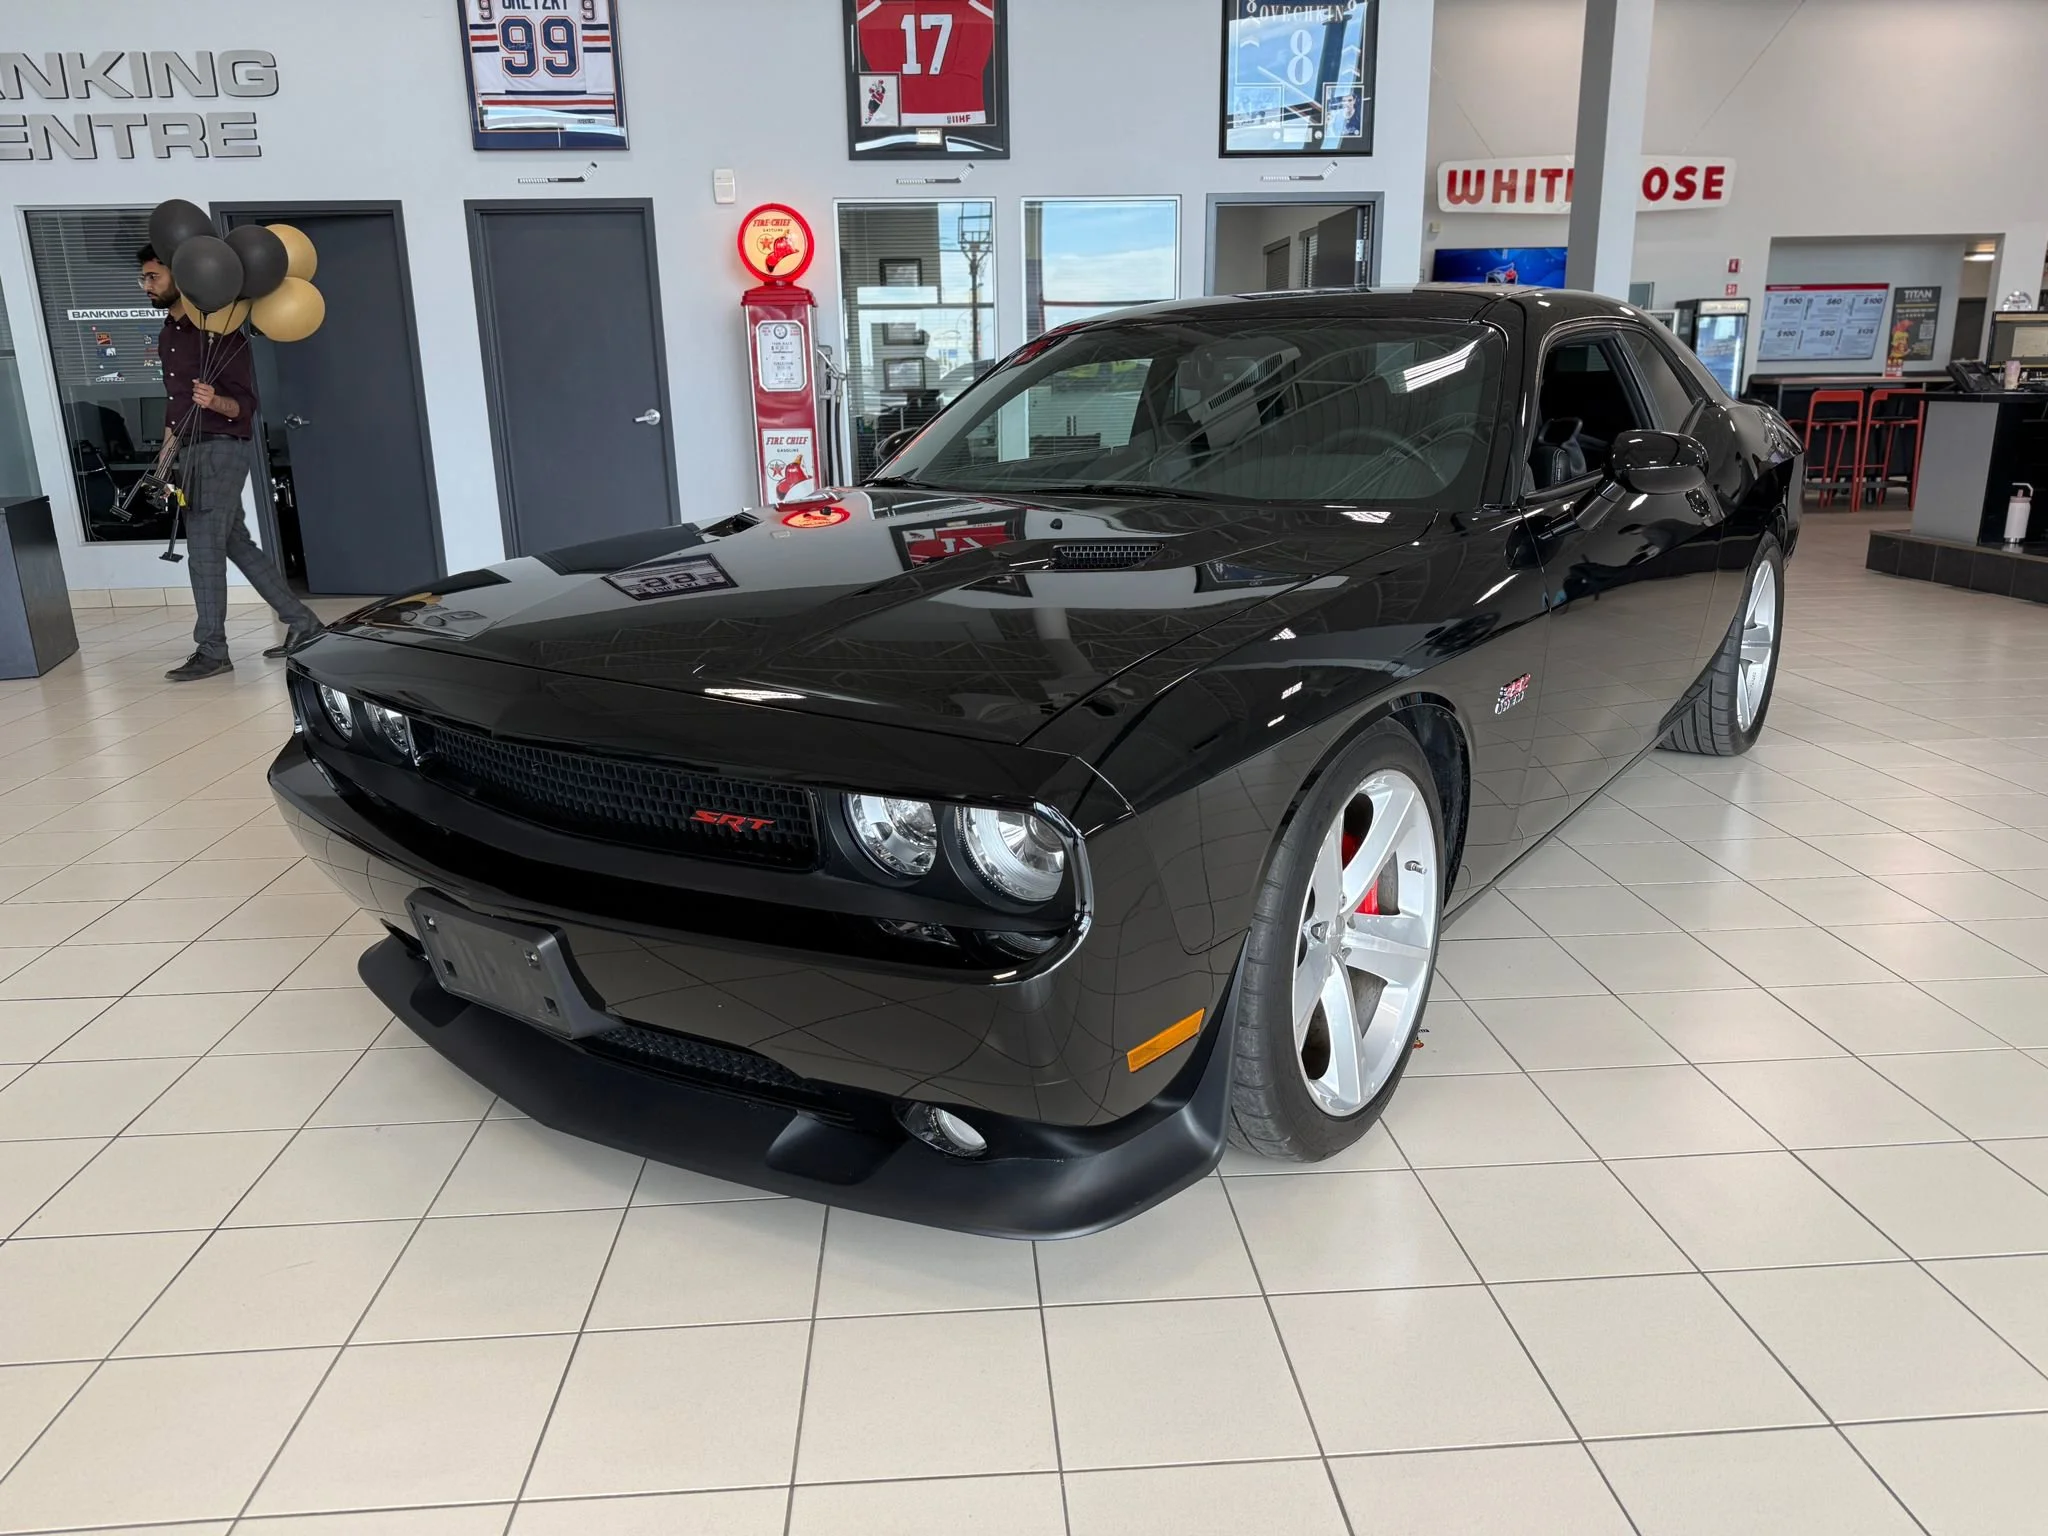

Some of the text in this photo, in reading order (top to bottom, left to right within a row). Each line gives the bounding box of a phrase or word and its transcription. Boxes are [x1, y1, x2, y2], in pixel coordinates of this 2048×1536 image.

[1260, 4, 1344, 22] OVECHKIN
[499, 16, 579, 77] 99
[901, 14, 953, 75] 17
[1287, 29, 1314, 85] 8
[0, 50, 280, 99] NKING
[952, 115, 971, 123] IIHF
[1446, 165, 1725, 205] WHIT OSE
[1904, 289, 1933, 299] TITAN
[72, 308, 169, 319] BANKING CENTR
[766, 436, 809, 446] FIRE CHIEF
[690, 810, 776, 833] SRT
